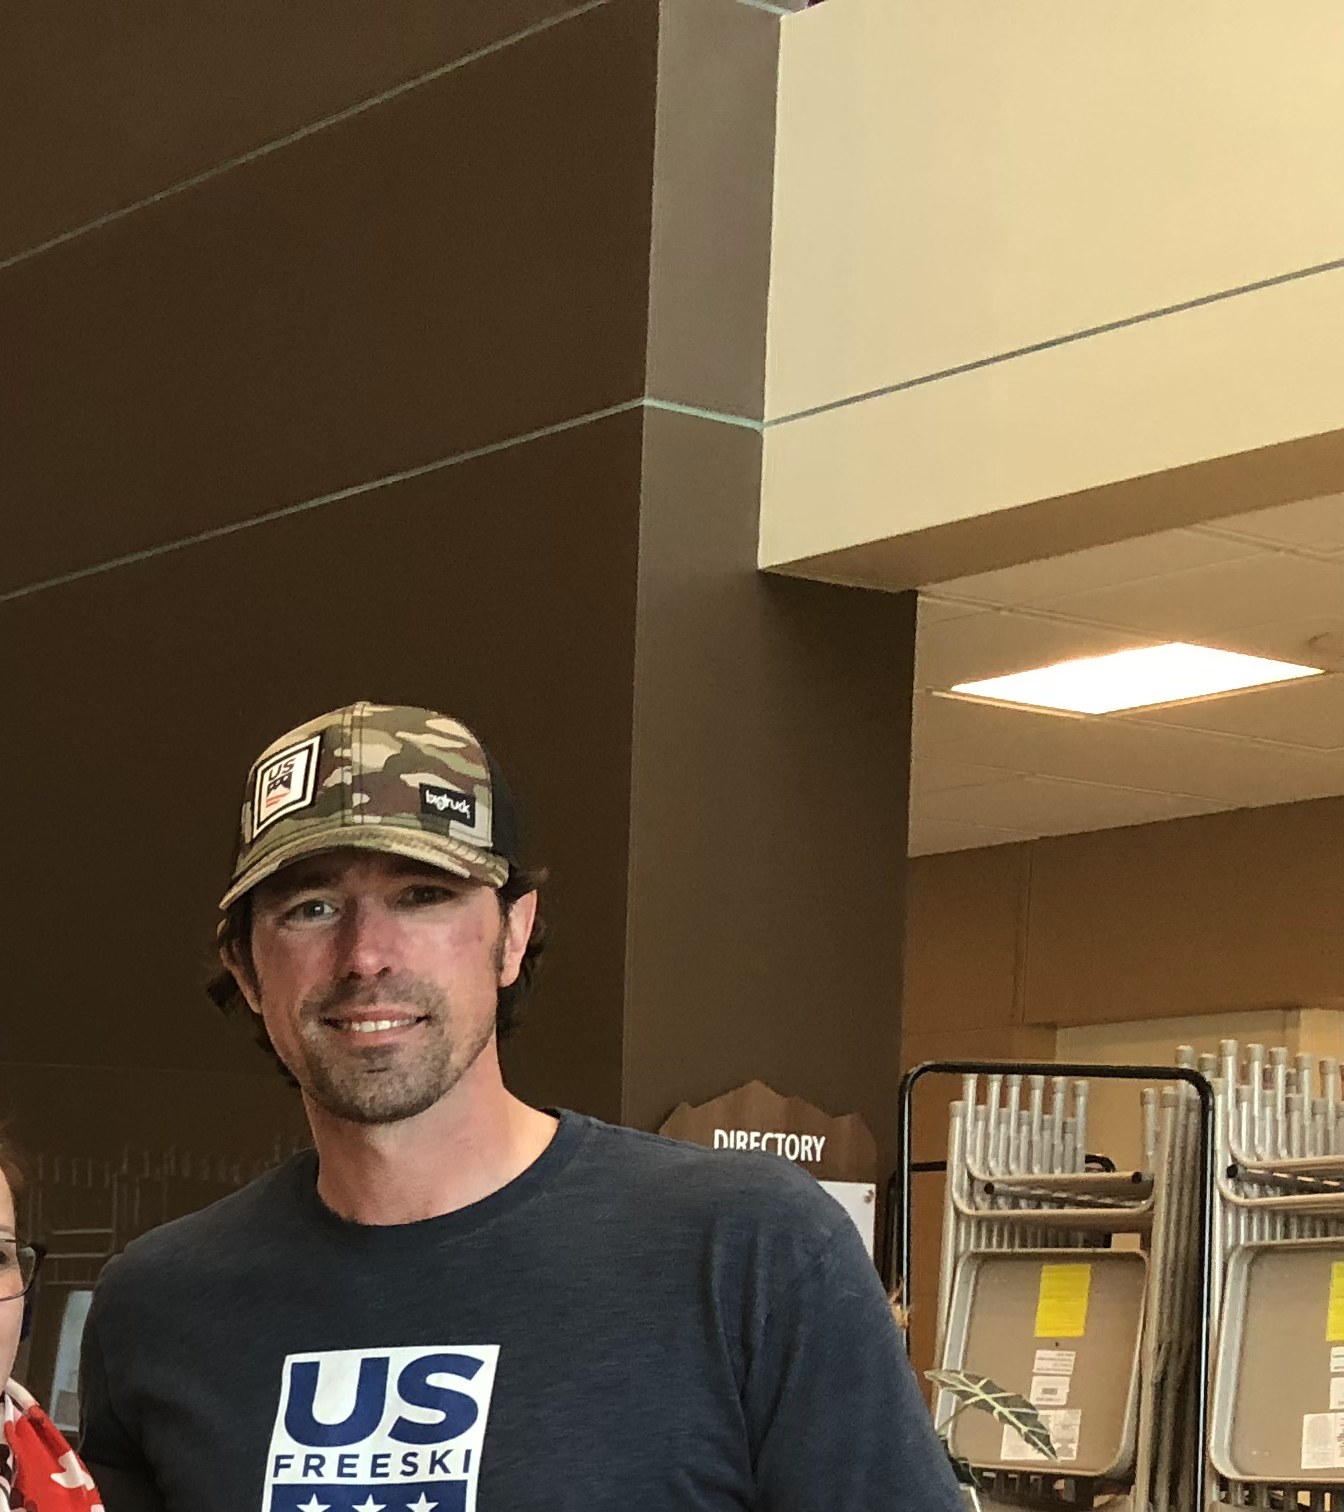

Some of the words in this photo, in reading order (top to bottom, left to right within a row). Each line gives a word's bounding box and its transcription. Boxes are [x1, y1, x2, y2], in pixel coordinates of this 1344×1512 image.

[269, 757, 297, 780] US
[713, 1129, 826, 1162] DIRECTORY
[284, 1352, 486, 1448] US
[272, 1449, 473, 1479] FREESKI
